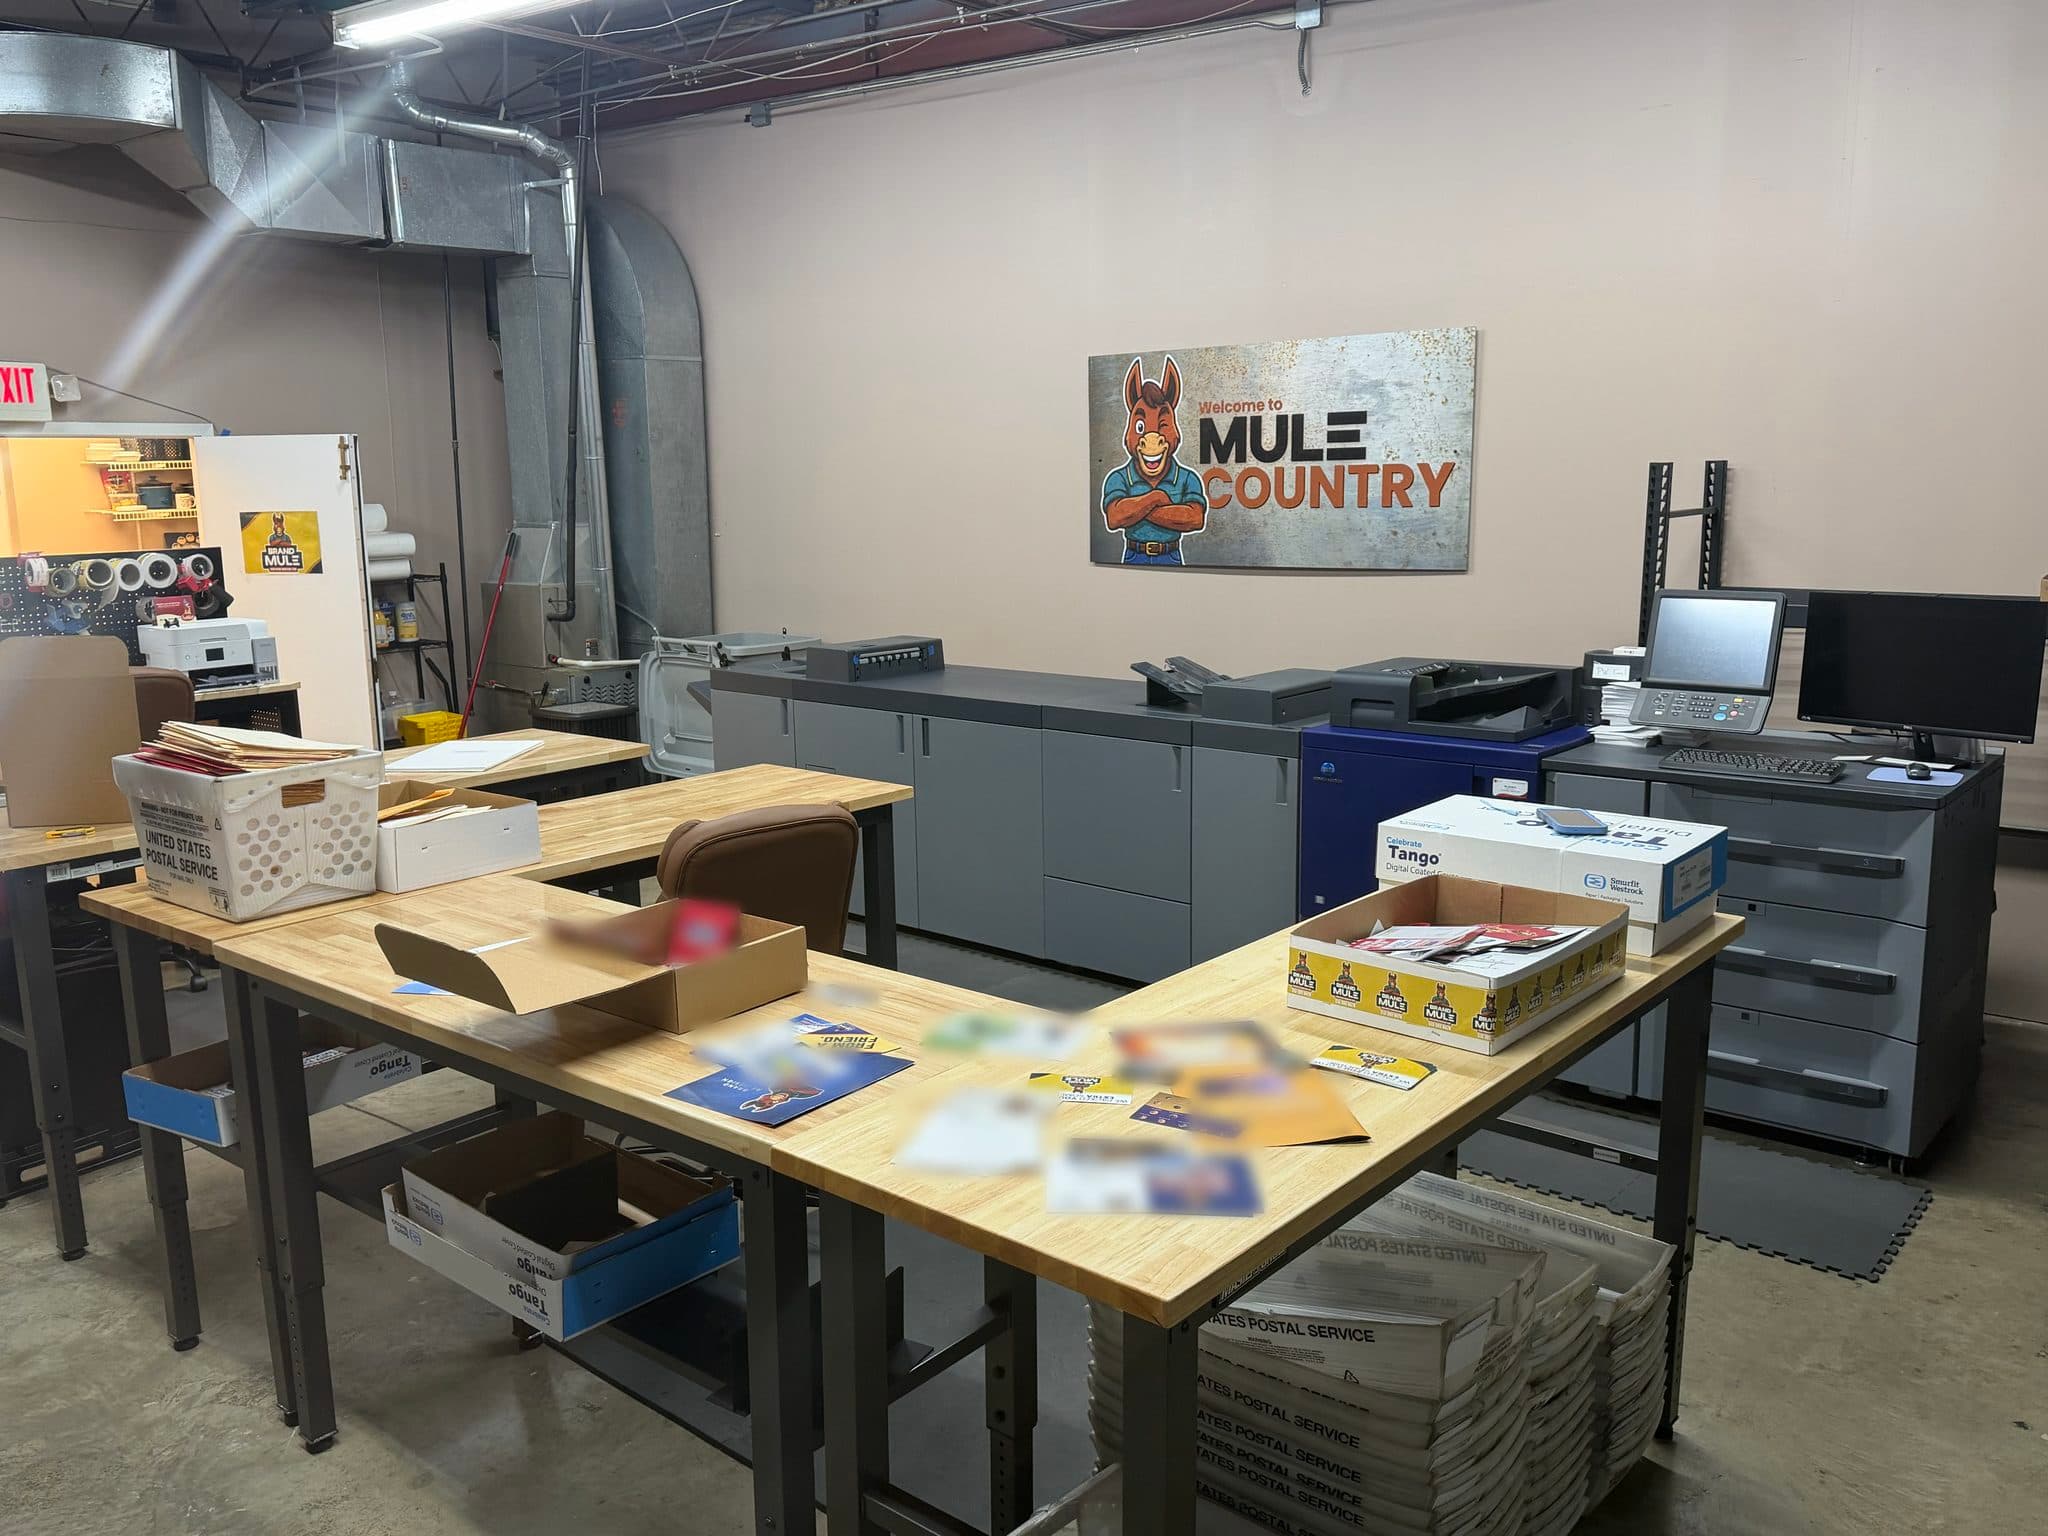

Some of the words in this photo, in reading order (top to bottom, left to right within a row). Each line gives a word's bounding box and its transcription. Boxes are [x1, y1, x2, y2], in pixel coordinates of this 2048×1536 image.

[0, 367, 35, 404] XIT
[1199, 400, 1264, 415] Welcome
[1268, 398, 1283, 411] to
[1200, 410, 1367, 464] MULE
[1203, 462, 1456, 510] COUNTRY
[267, 547, 295, 555] BRAND
[264, 555, 301, 567] MULE
[1619, 824, 1692, 837] Digital
[145, 829, 175, 850] UNITED
[177, 838, 211, 860] STATES
[1386, 836, 1422, 848] Celebrate
[146, 848, 178, 870] POSTAL
[179, 858, 218, 880] SERVICE
[1388, 845, 1440, 867] Tango
[1386, 862, 1409, 873] Digital
[1610, 877, 1640, 888] Smurfit
[1610, 884, 1644, 895] Westrock
[1289, 976, 1315, 989] MULE
[1332, 986, 1359, 1000] MULE
[1378, 998, 1406, 1011] MULE
[1425, 1009, 1455, 1022] MULE
[1478, 1015, 1497, 1023] BRAN
[820, 1036, 879, 1044] FRIEND.
[370, 1055, 412, 1076] Tango
[508, 1284, 548, 1316] Tango
[1208, 1312, 1246, 1329] ATES
[1250, 1317, 1306, 1336] POSTAL
[1307, 1324, 1376, 1343] SERVICE
[1197, 1374, 1232, 1398] ATES
[1234, 1389, 1291, 1423] POSTAL
[1293, 1415, 1360, 1449] SERVICE
[1197, 1410, 1233, 1433] ATES
[1235, 1425, 1293, 1457] POSTAL
[1295, 1448, 1361, 1484] SERVICE
[1199, 1430, 1235, 1455] ATES
[1196, 1446, 1236, 1472] TATES
[1238, 1464, 1295, 1498] POSTAL
[1297, 1490, 1365, 1527] SERVICE
